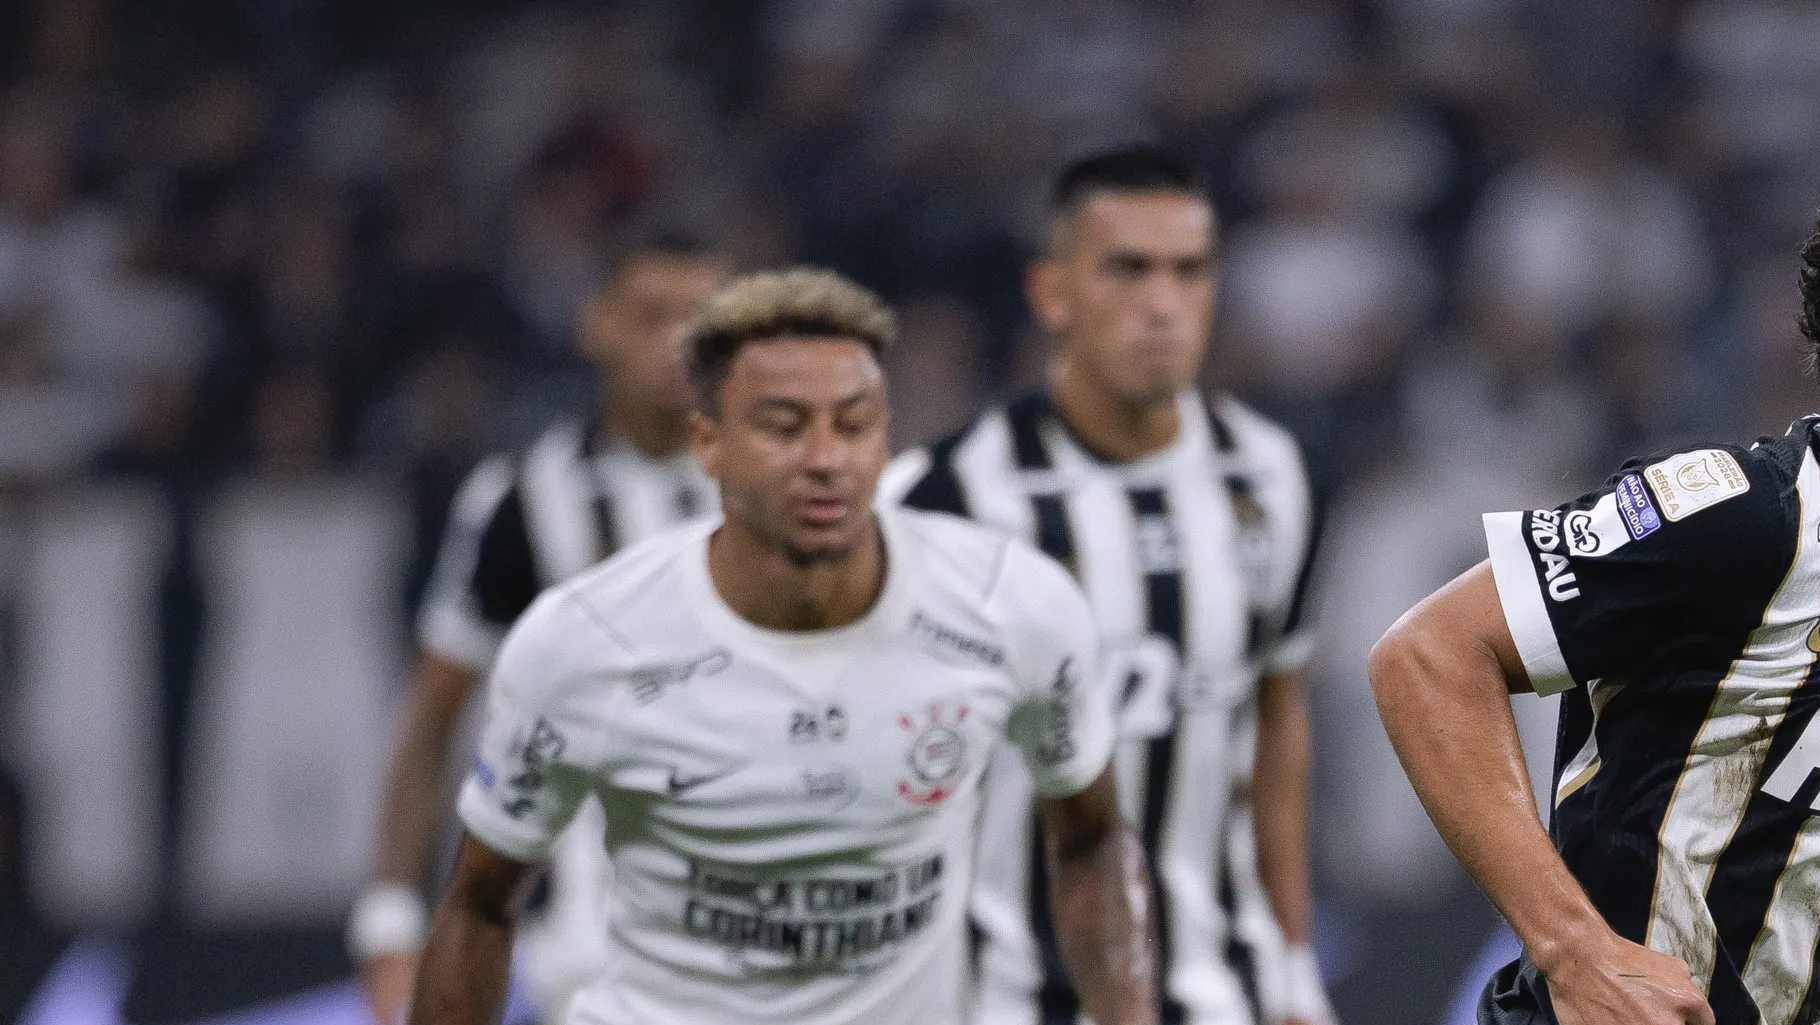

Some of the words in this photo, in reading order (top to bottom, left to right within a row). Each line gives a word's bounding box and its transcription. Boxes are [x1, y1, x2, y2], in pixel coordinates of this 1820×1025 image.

[1714, 458, 1731, 479] 2026
[1626, 475, 1639, 494] NÃO
[1634, 493, 1646, 508] AO
[1652, 468, 1676, 502] SÉRIE
[1668, 503, 1680, 514] A
[1531, 509, 1581, 602] ERDAU
